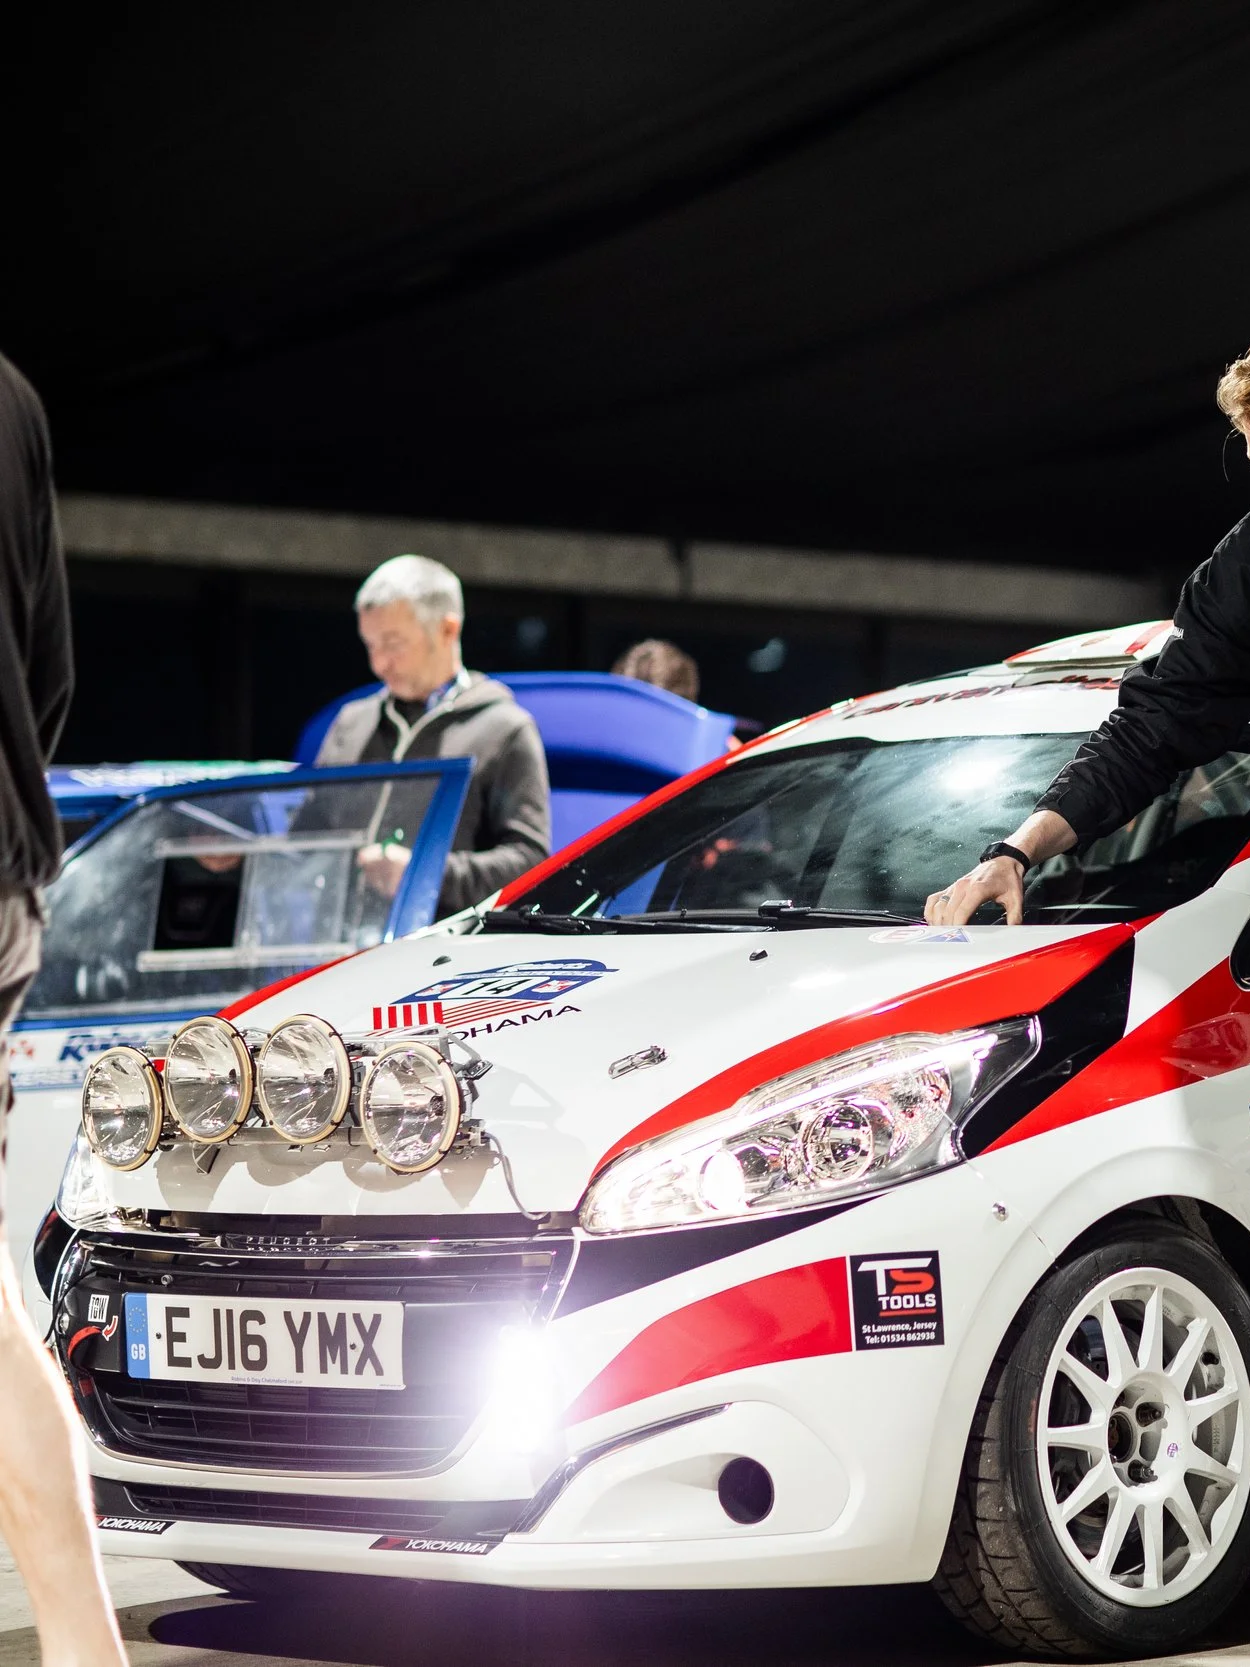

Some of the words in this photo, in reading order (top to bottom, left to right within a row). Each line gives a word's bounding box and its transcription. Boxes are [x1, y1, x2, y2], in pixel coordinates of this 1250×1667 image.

[461, 979, 533, 996] 14
[448, 1005, 582, 1044] OHAMA
[246, 1236, 330, 1245] PEUGEOT
[857, 1257, 935, 1296] TS
[91, 1297, 107, 1320] TOW
[878, 1293, 937, 1310] TOOLS
[862, 1324, 871, 1333] St
[872, 1322, 912, 1333] Lawrence,
[913, 1321, 937, 1331] Jersey
[165, 1306, 268, 1371] EJ16
[284, 1310, 385, 1376] YMX
[865, 1335, 880, 1344] Tel:
[881, 1334, 905, 1343] 01534
[906, 1332, 935, 1341] 862938
[131, 1343, 146, 1360] GB
[98, 1517, 166, 1532] YOKOHAMA
[405, 1539, 488, 1553] YOKOHAMA
